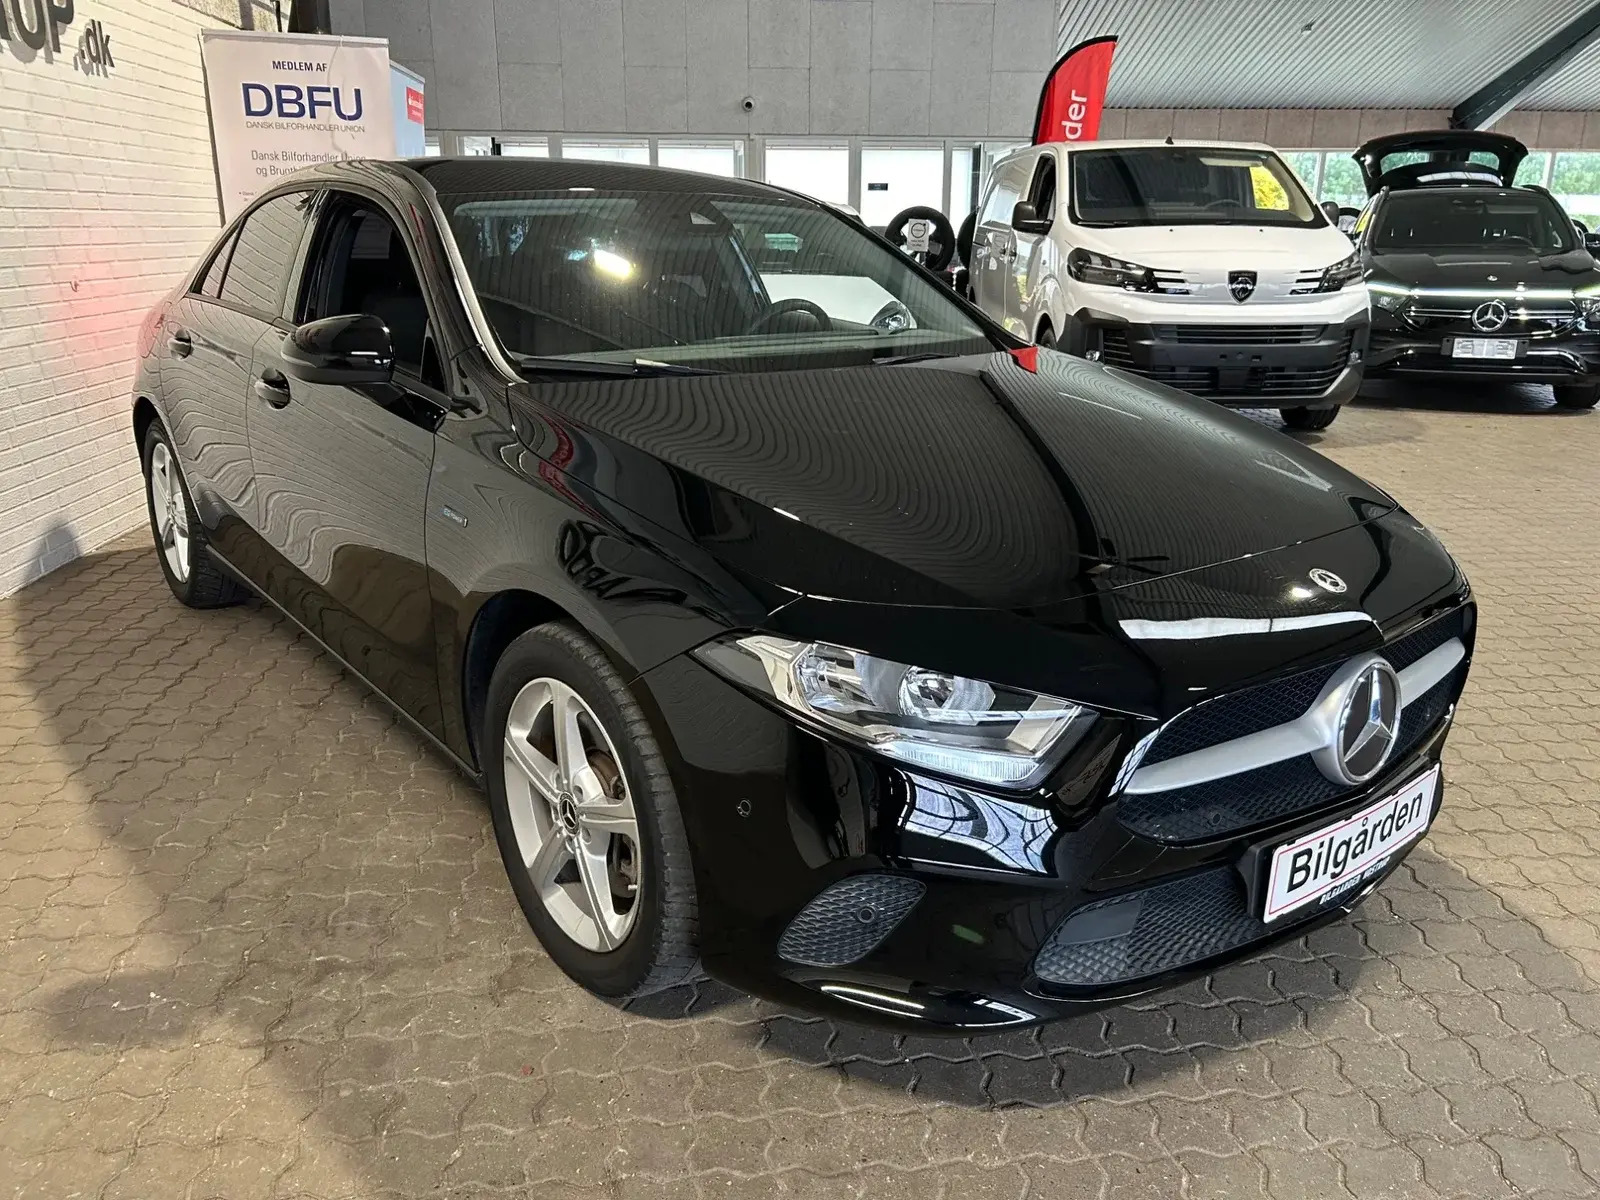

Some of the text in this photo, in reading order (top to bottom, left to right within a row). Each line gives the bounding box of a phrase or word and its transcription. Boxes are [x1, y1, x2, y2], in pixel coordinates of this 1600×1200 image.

[272, 60, 328, 72] MEDLEM AF
[242, 82, 363, 121] DBFU
[1061, 89, 1088, 143] der
[246, 121, 366, 133] DANSK BILFORHANDLER UNION
[251, 149, 280, 161] Dansk
[281, 151, 338, 163] Bilforhandler
[256, 167, 268, 178] og
[1286, 791, 1424, 894] Bilgården
